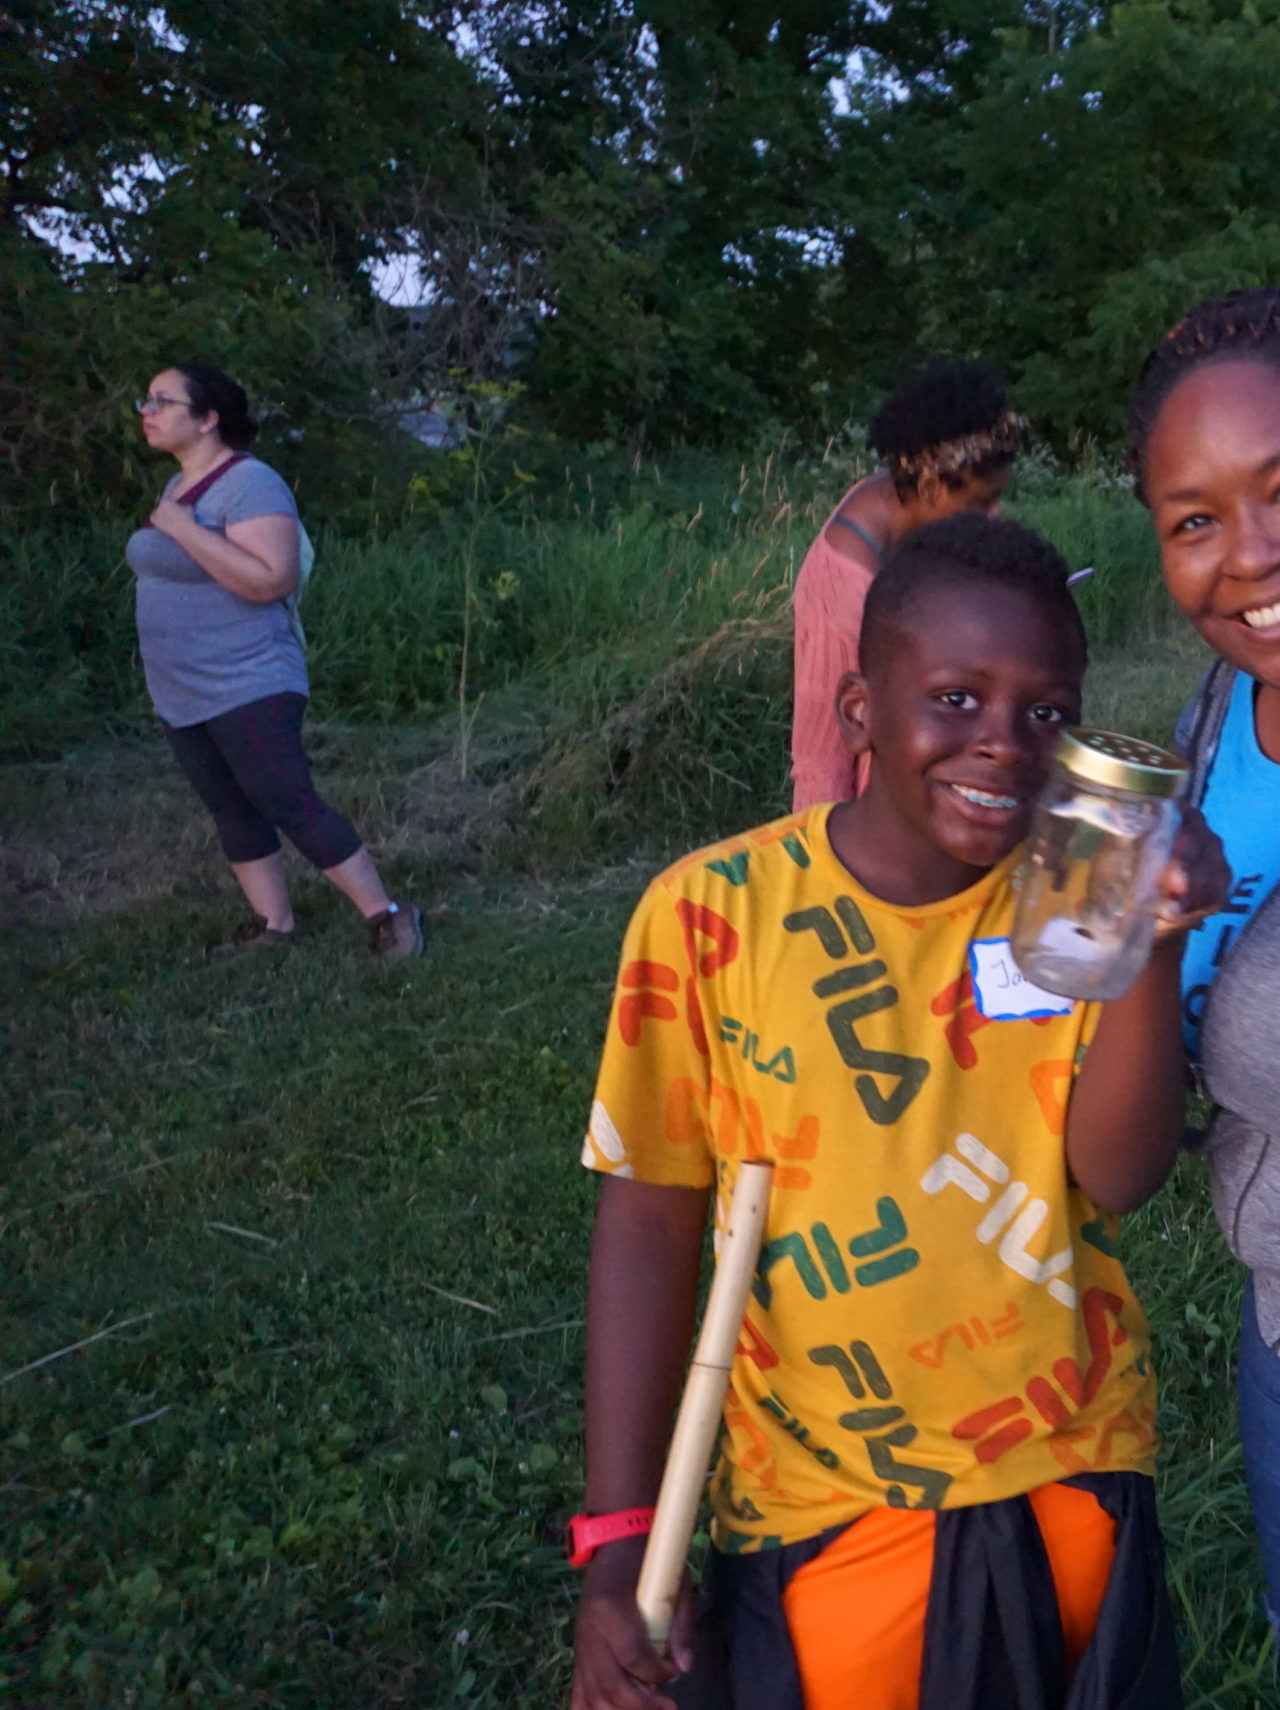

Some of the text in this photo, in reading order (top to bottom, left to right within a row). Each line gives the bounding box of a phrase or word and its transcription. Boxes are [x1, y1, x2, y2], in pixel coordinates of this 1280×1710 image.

[990, 958, 1028, 989] Ja
[783, 895, 930, 1125] FILA
[720, 1016, 797, 1084] FILA
[752, 1196, 920, 1310] FIL
[907, 1302, 1025, 1368] FILA
